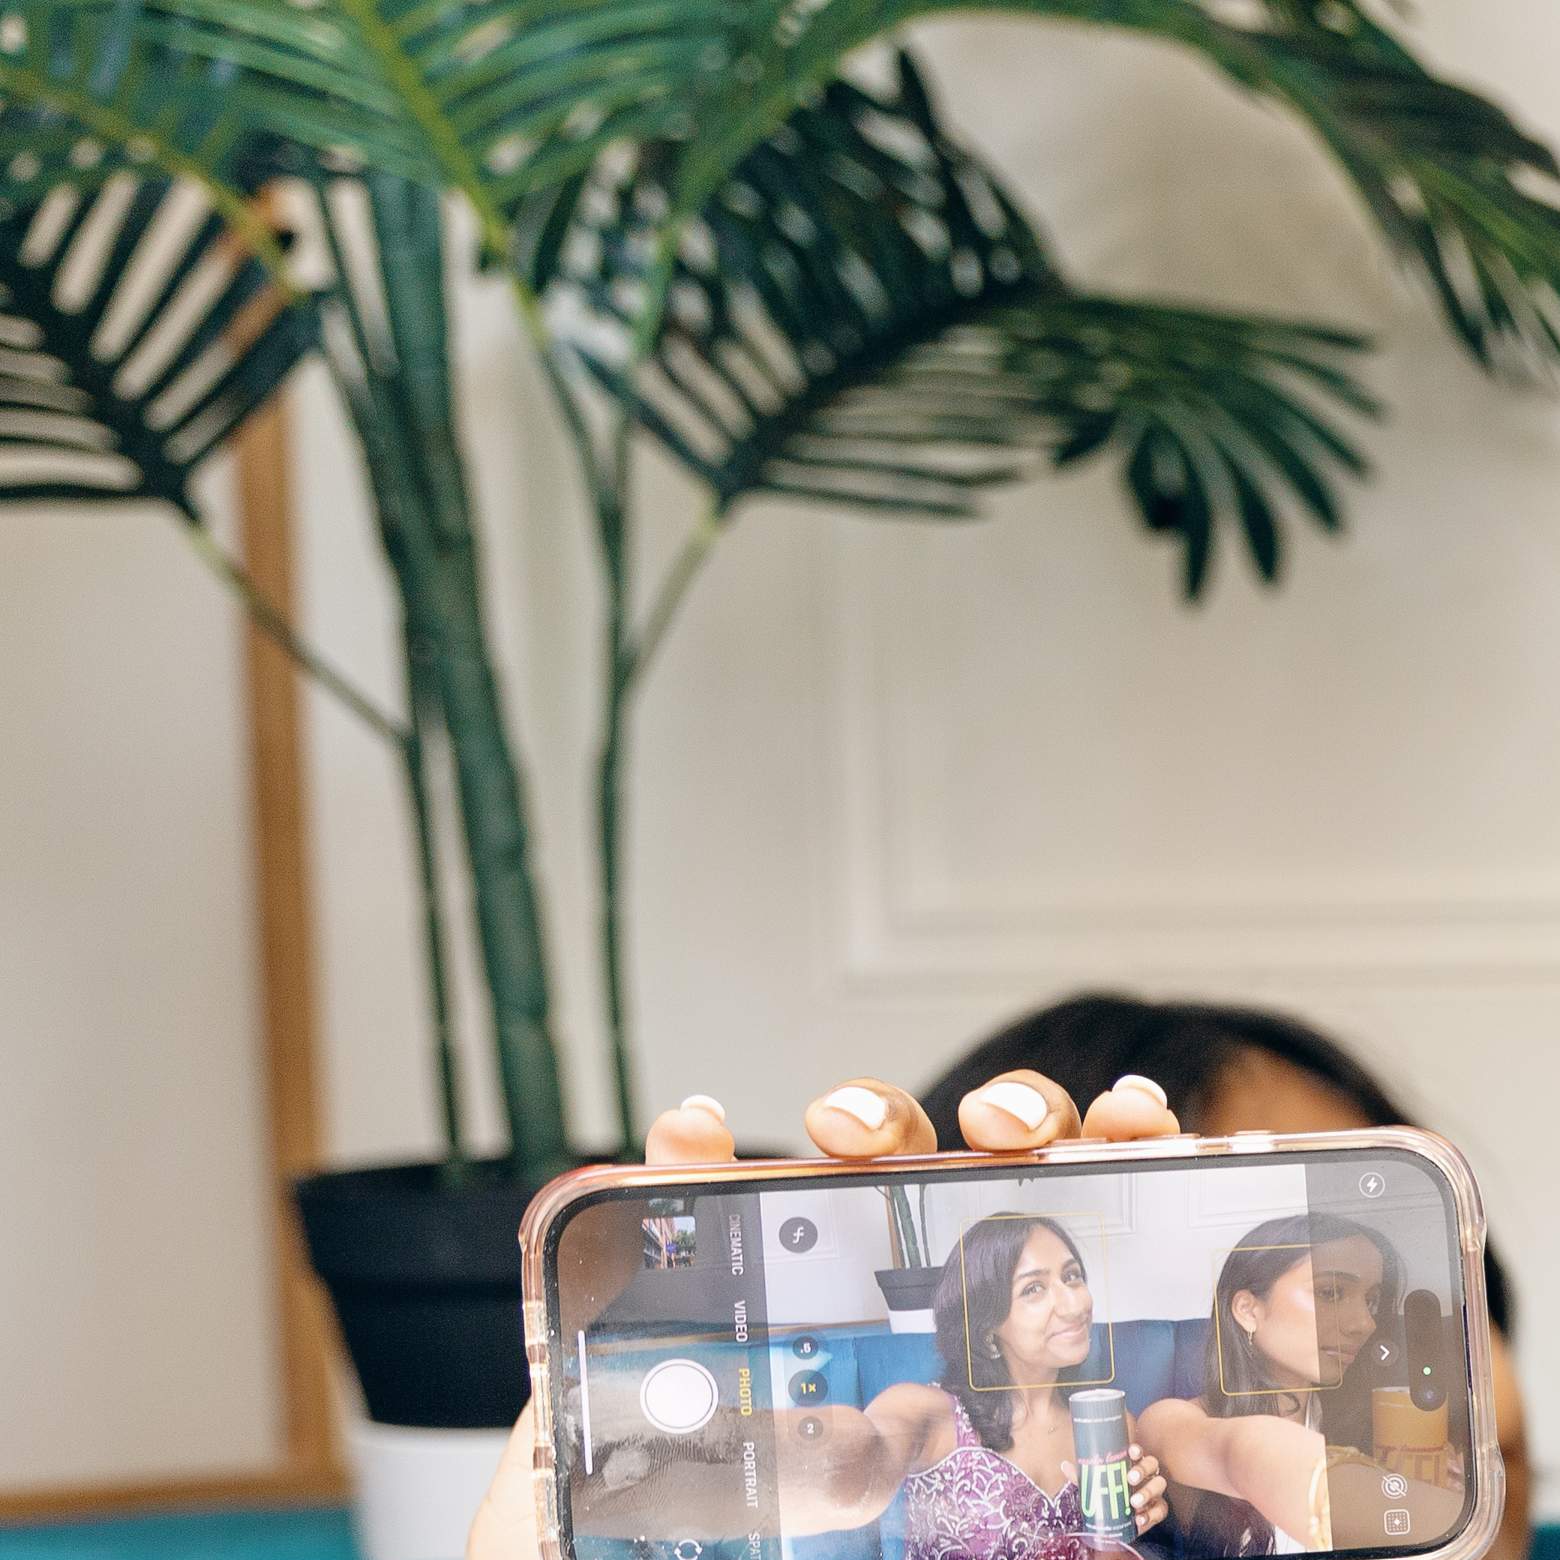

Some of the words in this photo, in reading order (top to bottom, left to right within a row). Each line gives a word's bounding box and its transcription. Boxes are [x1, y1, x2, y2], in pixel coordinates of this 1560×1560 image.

[728, 1214, 744, 1276] CINEMATIC
[734, 1300, 748, 1343] VIDEO
[738, 1368, 753, 1416] PHOTO
[807, 1423, 814, 1434] 2
[743, 1442, 758, 1508] PORTRAIT
